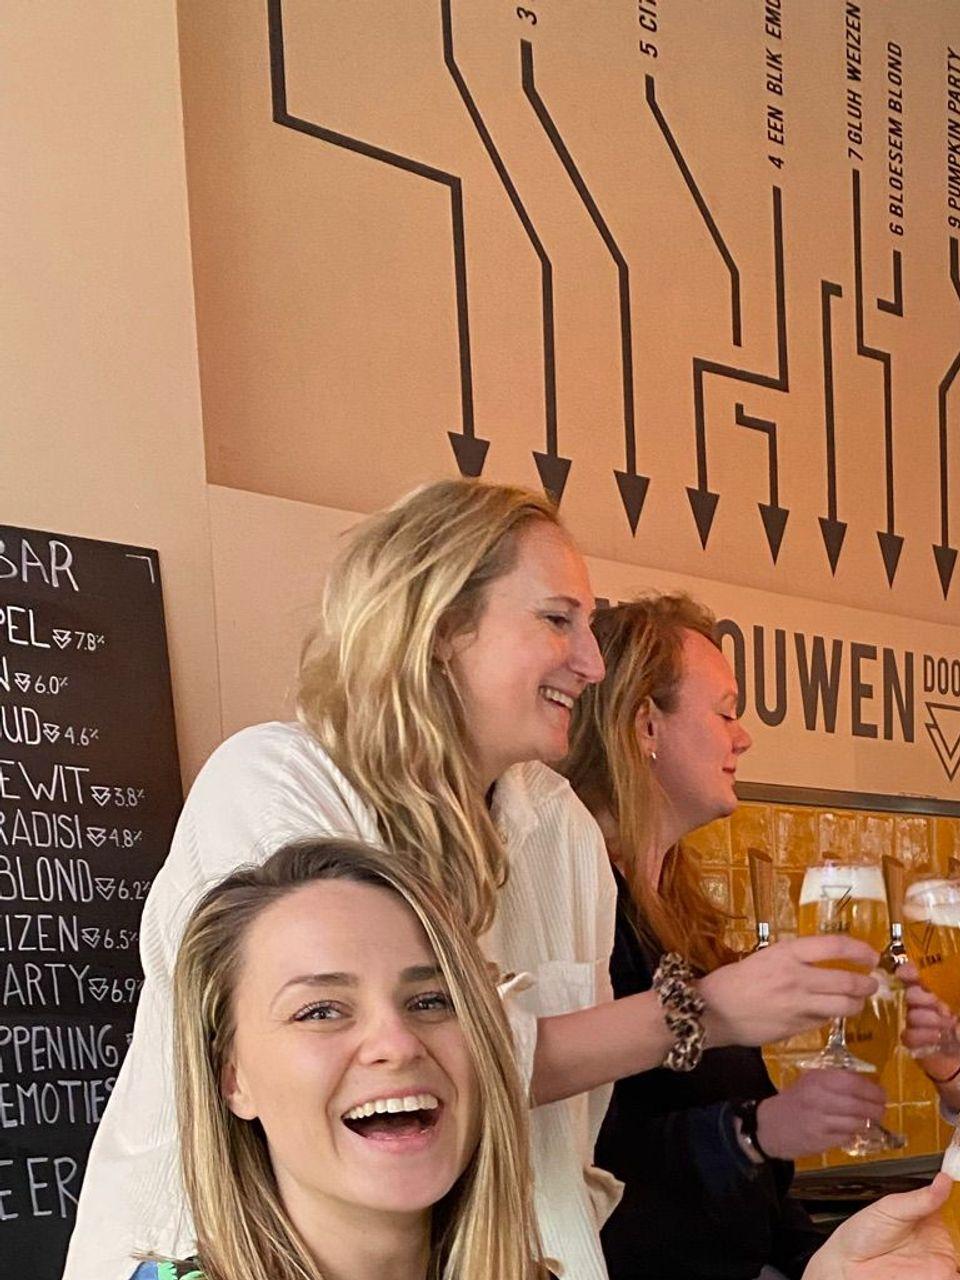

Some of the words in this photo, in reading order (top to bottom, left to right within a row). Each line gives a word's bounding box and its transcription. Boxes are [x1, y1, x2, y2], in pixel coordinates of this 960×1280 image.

[517, 6, 538, 26] 3
[639, 40, 658, 58] 5
[846, 2, 862, 82] WEIZEN
[766, 48, 784, 96] BLIK
[887, 41, 903, 114] BLOND
[767, 105, 785, 145] EEN
[847, 89, 863, 145] GLUH
[768, 154, 785, 170] 4
[848, 147, 863, 161] 7
[888, 117, 904, 218] BLOESEM
[889, 222, 904, 236] 6
[0, 605, 51, 649] EL
[713, 618, 915, 744] OUWEN
[0, 855, 93, 902] BLOND
[3, 962, 90, 1006] ARTY
